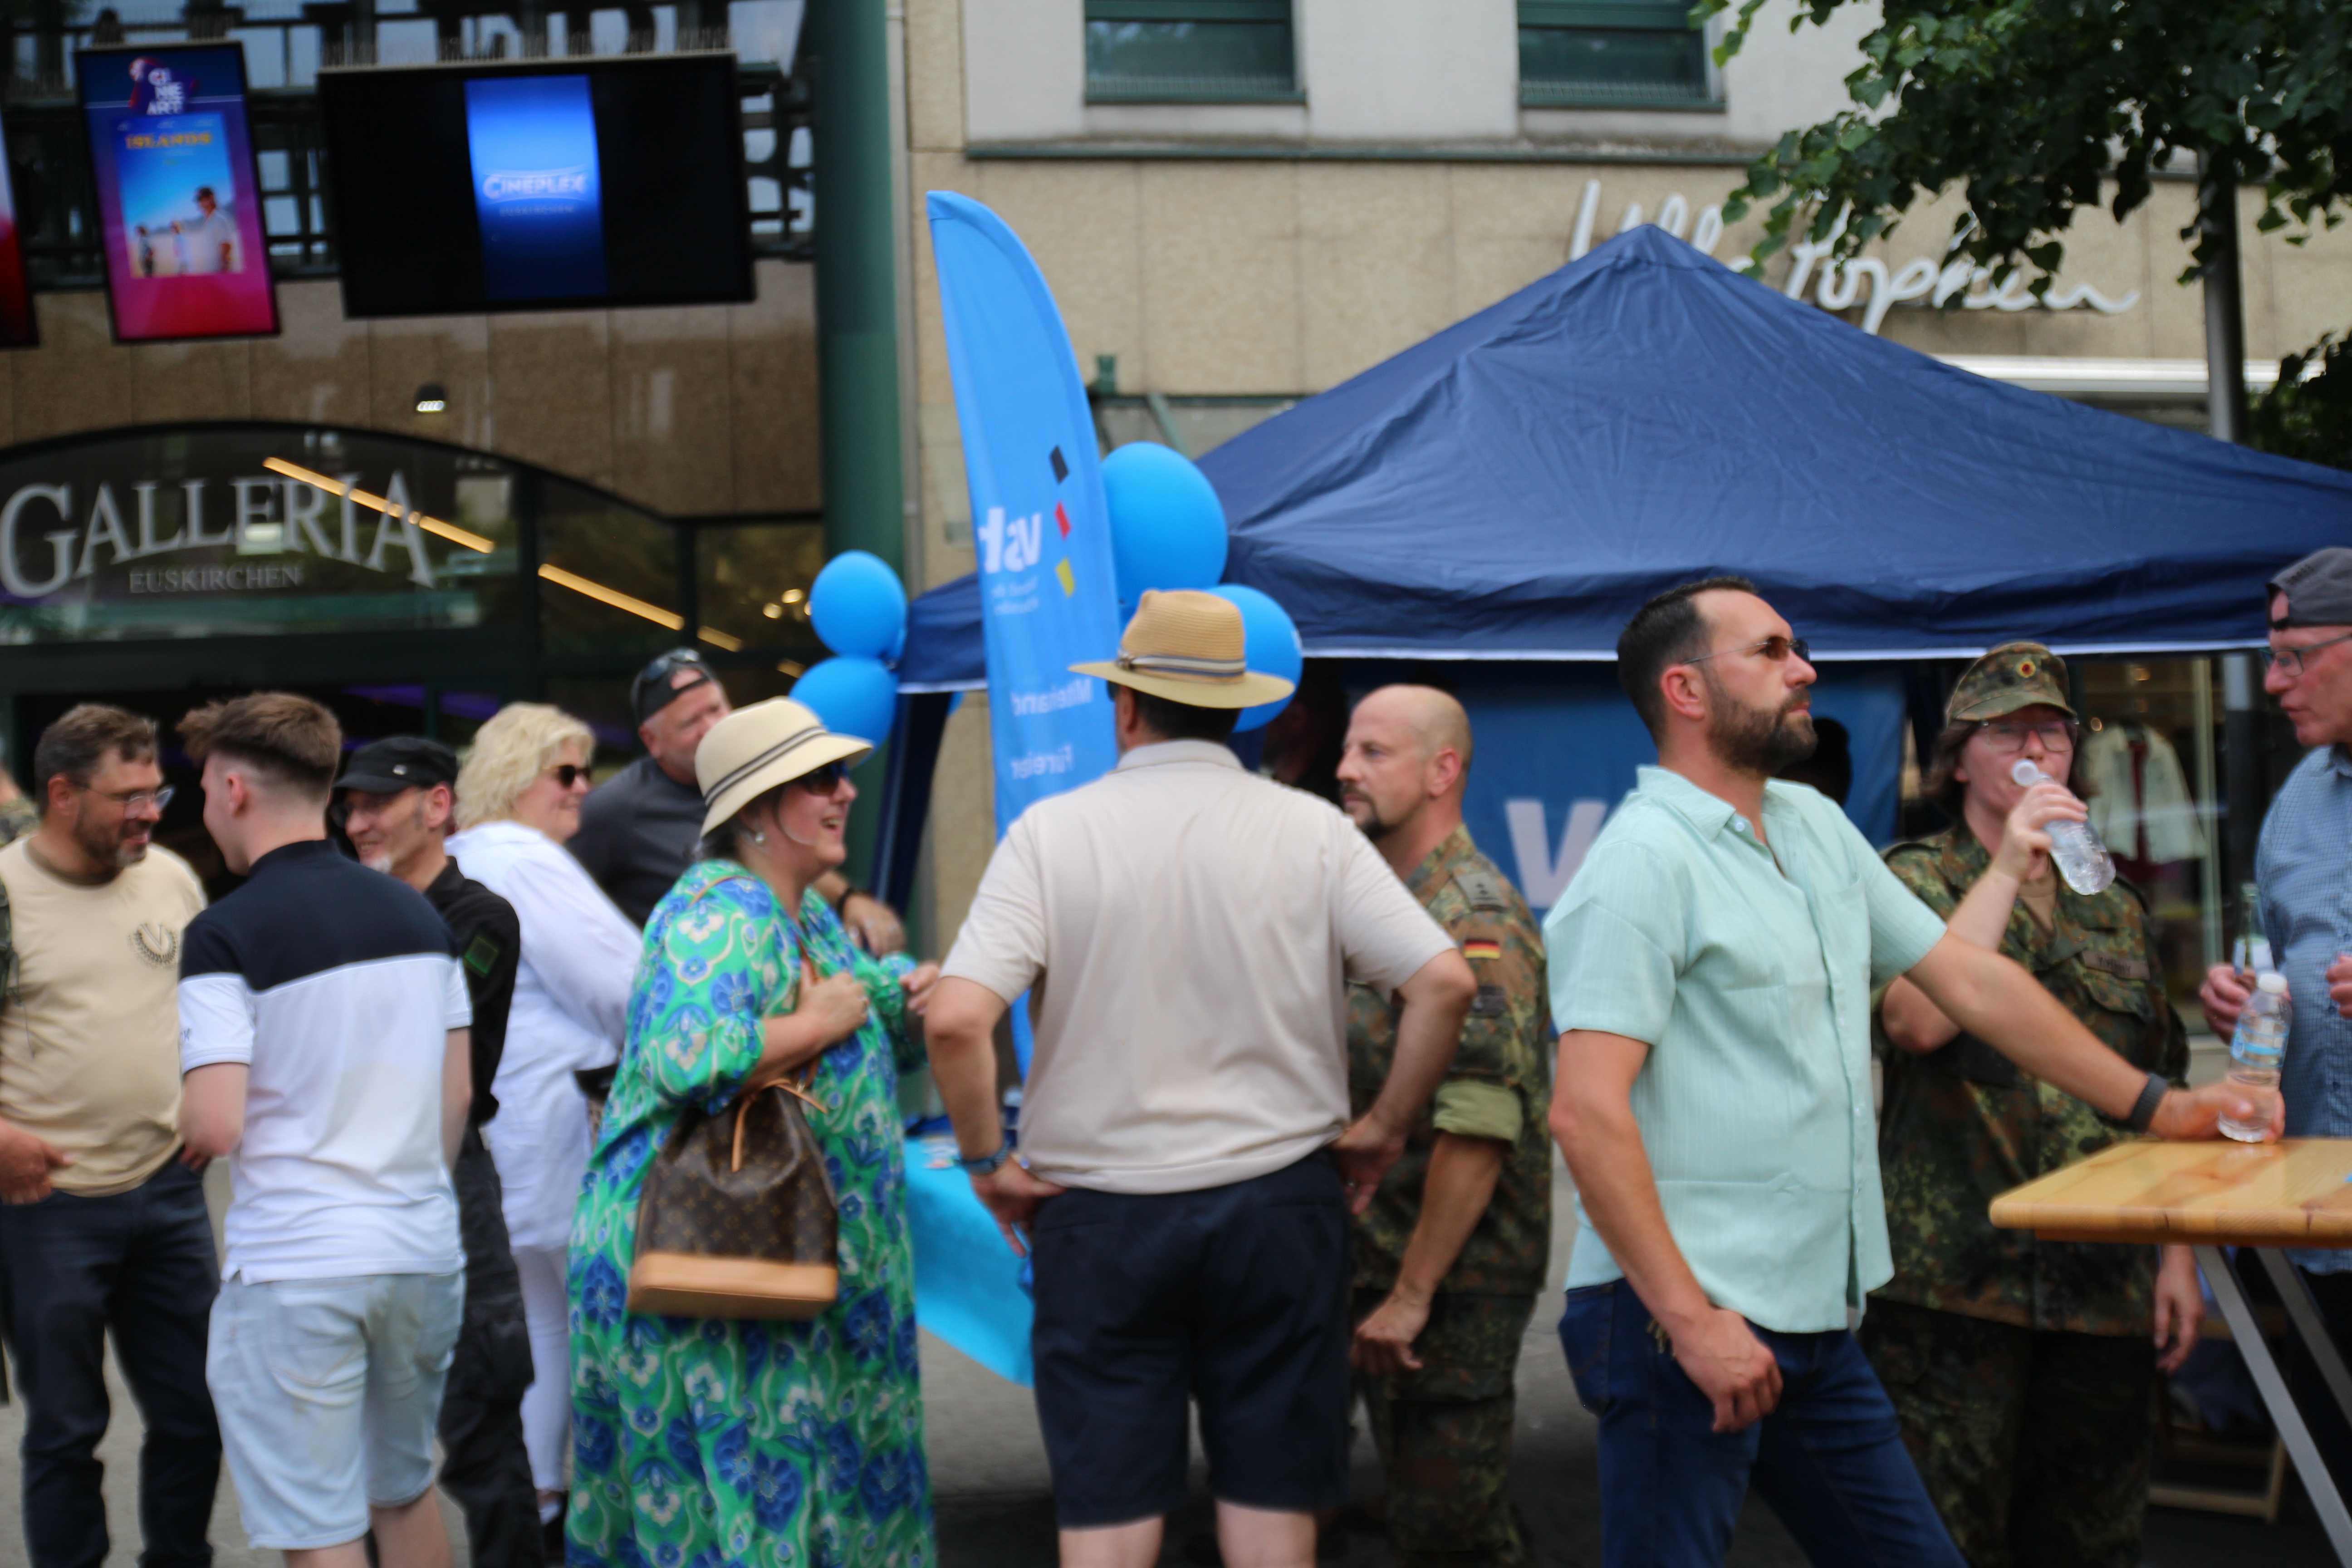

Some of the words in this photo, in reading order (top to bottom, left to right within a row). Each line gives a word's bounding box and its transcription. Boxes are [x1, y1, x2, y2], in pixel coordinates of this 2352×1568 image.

[483, 172, 589, 199] CINEPLEX
[0, 469, 435, 598] GALLERIA
[129, 564, 303, 593] EUSKIRCHEN
